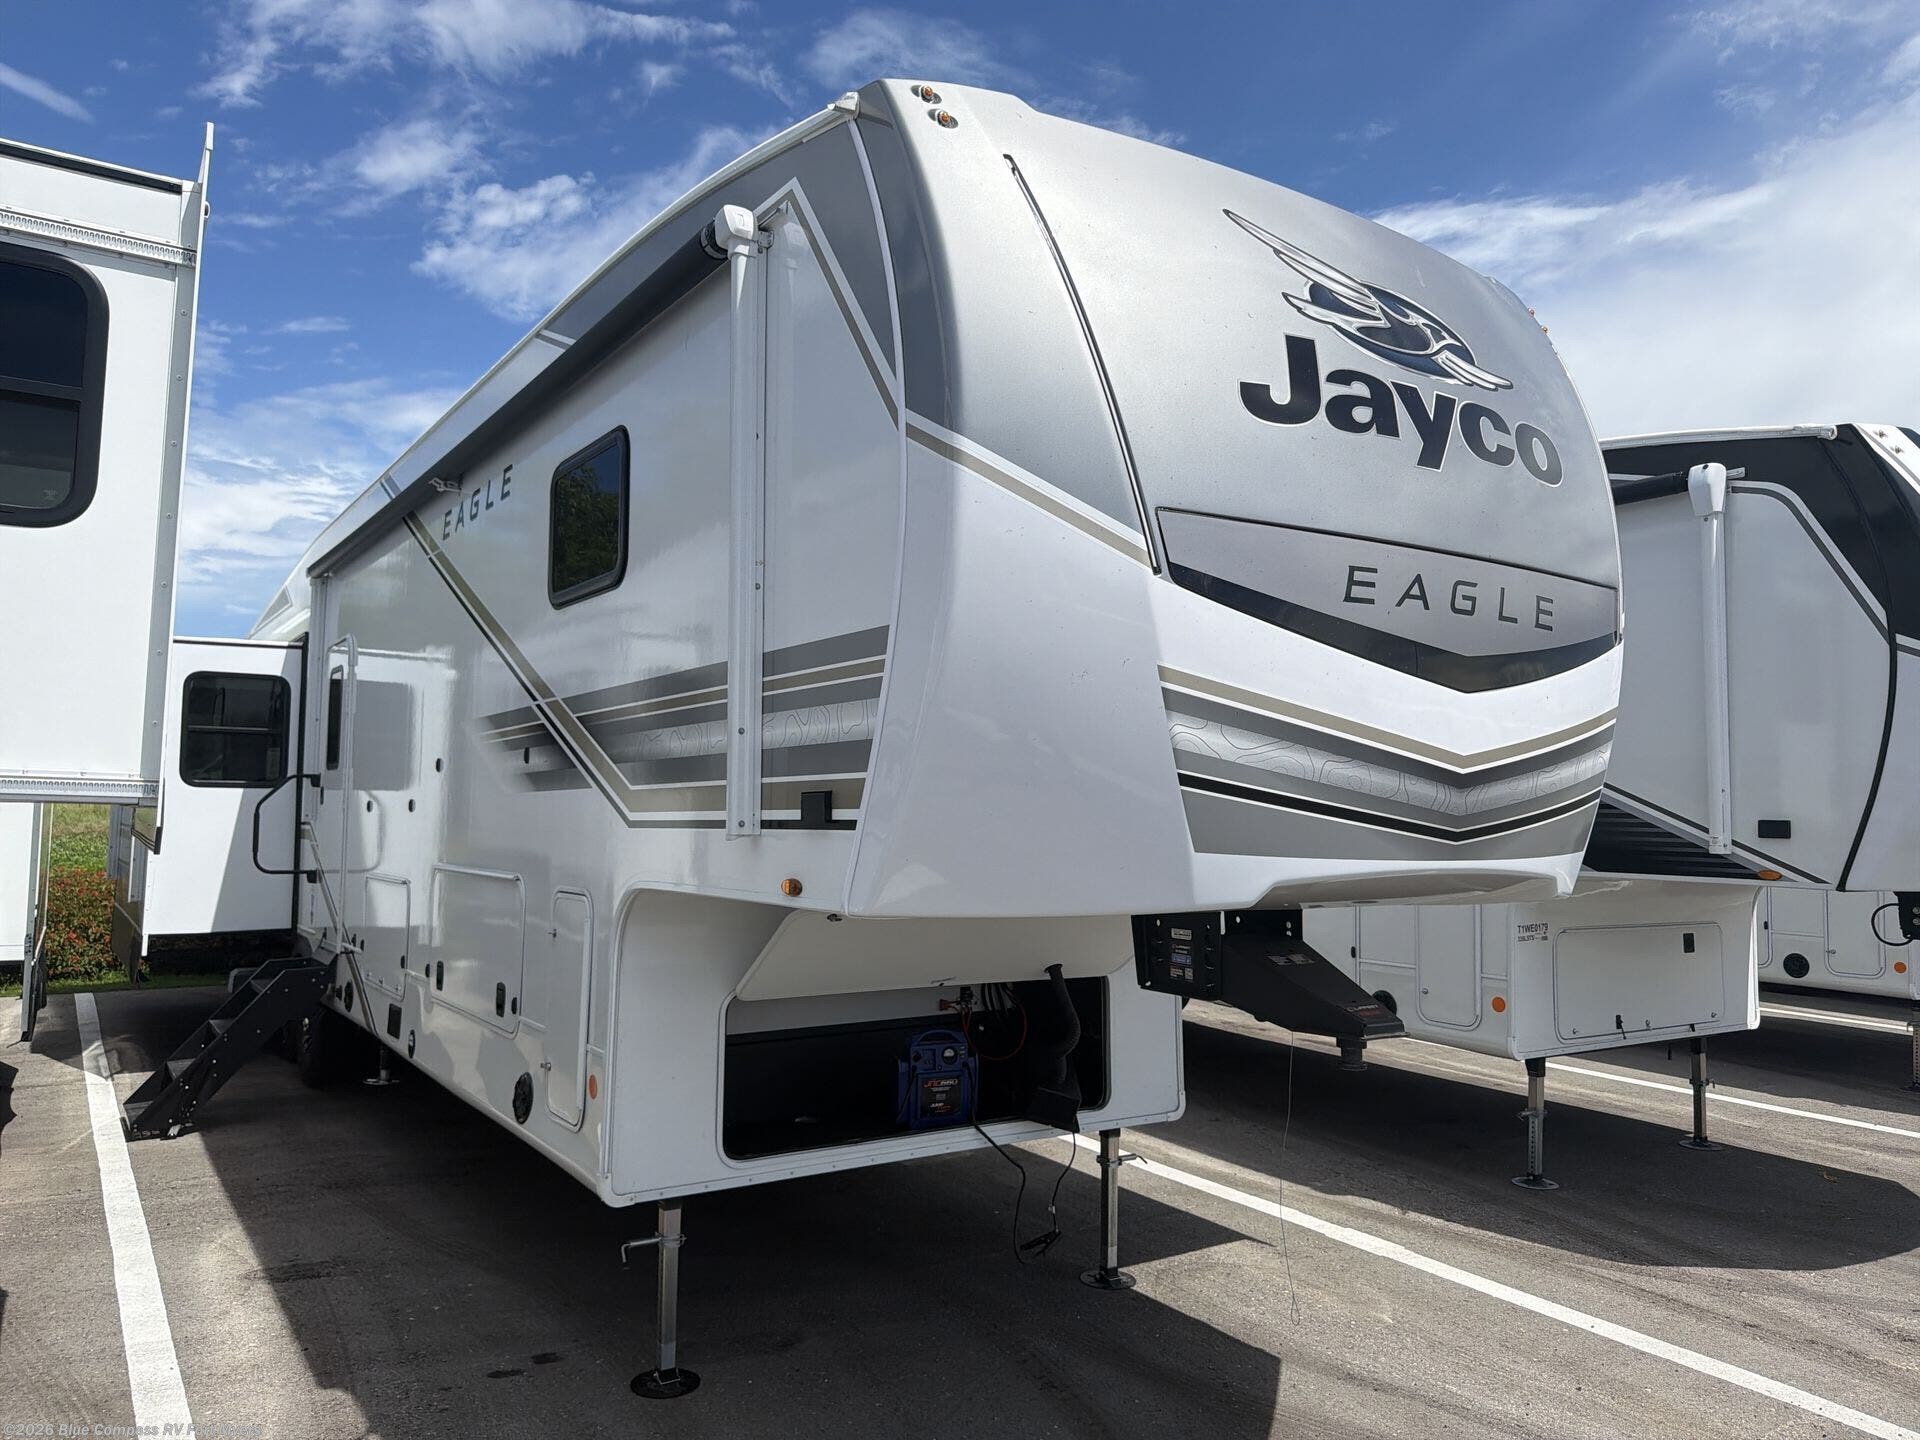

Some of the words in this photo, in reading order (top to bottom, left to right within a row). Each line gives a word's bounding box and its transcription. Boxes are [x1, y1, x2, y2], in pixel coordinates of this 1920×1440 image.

[1239, 333, 1564, 487] Jayco
[442, 464, 513, 541] EAGLE
[1343, 565, 1555, 632] EAGLE
